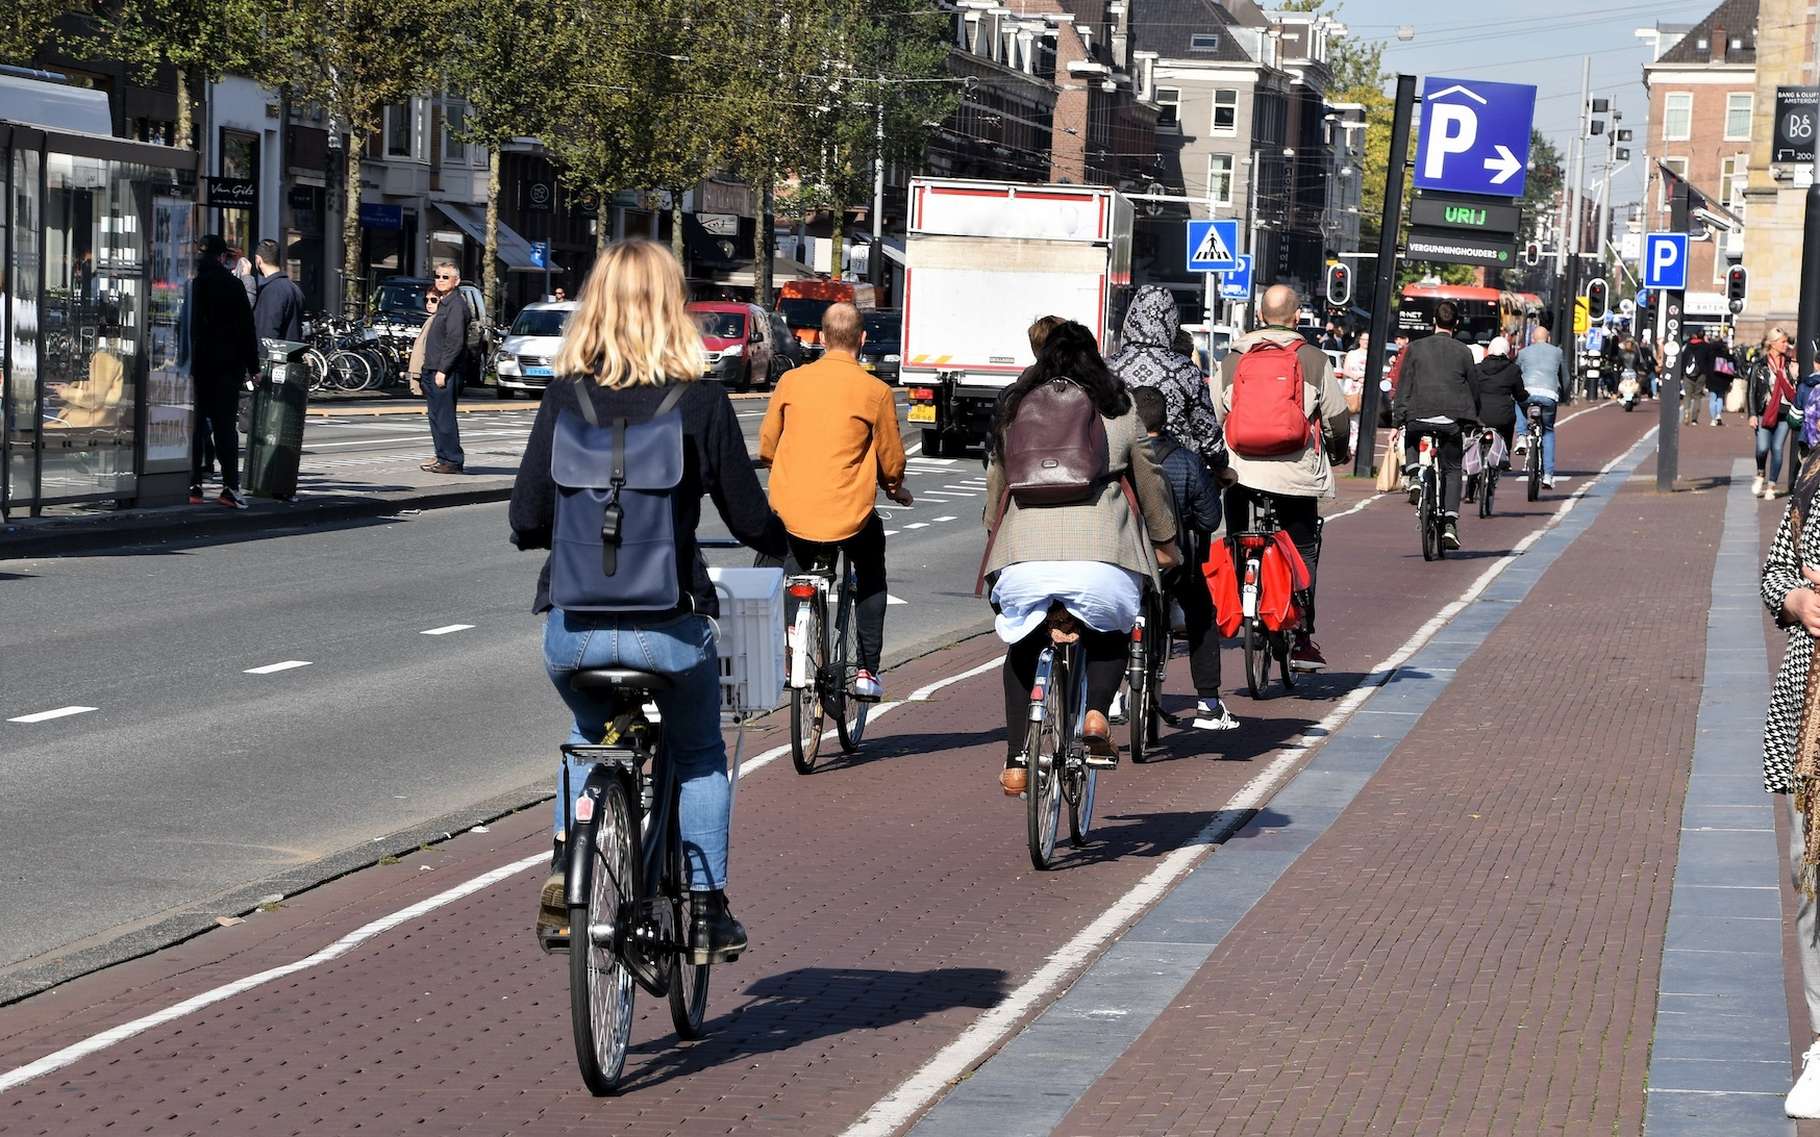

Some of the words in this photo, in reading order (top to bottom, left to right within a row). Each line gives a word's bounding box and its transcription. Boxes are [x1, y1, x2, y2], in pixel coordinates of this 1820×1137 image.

[1424, 102, 1478, 179] P
[211, 183, 231, 194] Van
[232, 184, 255, 198] Gils
[1409, 243, 1497, 259] VERGUNNINGHOUDERS
[1653, 239, 1678, 282] P
